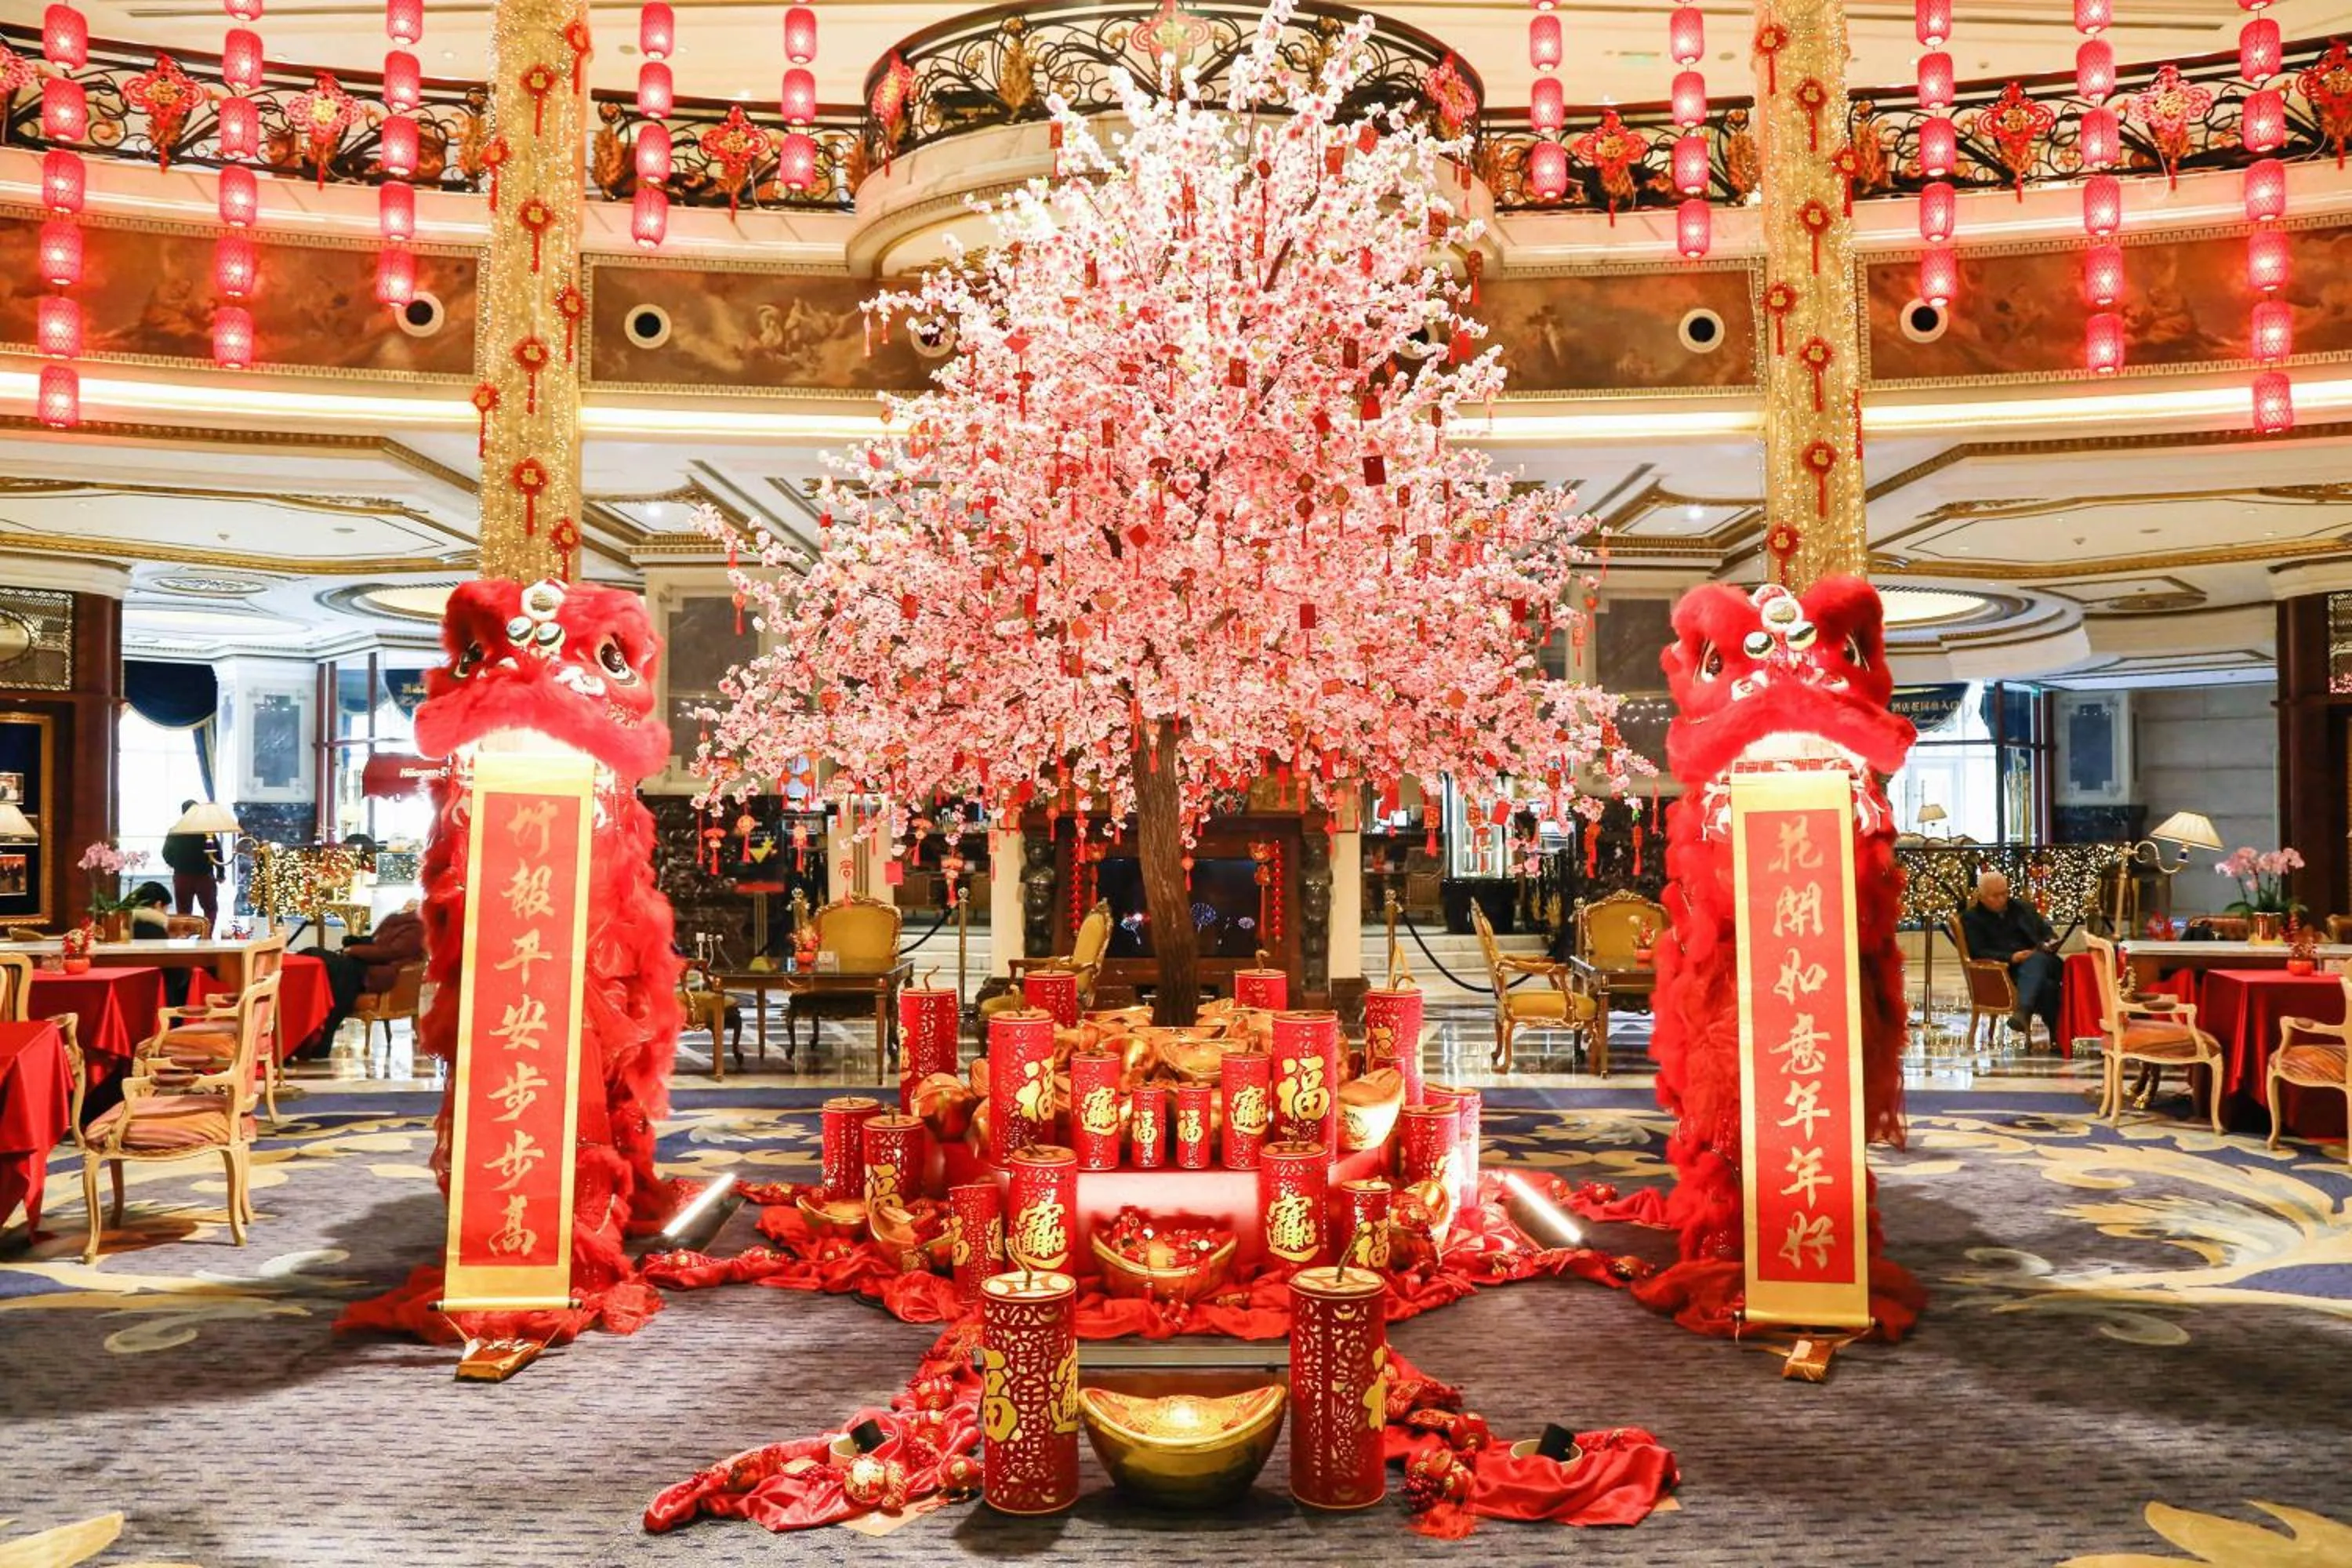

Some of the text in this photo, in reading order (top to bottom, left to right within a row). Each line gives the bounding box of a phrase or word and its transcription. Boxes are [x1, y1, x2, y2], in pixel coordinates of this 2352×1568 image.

[483, 800, 559, 1256] 竹報平安步步高
[1768, 815, 1836, 1269] 花開如意年年好
[1276, 1055, 1330, 1120] 福
[1132, 1110, 1158, 1144] 福
[1178, 1109, 1203, 1142] 福
[1356, 1218, 1390, 1268] 福
